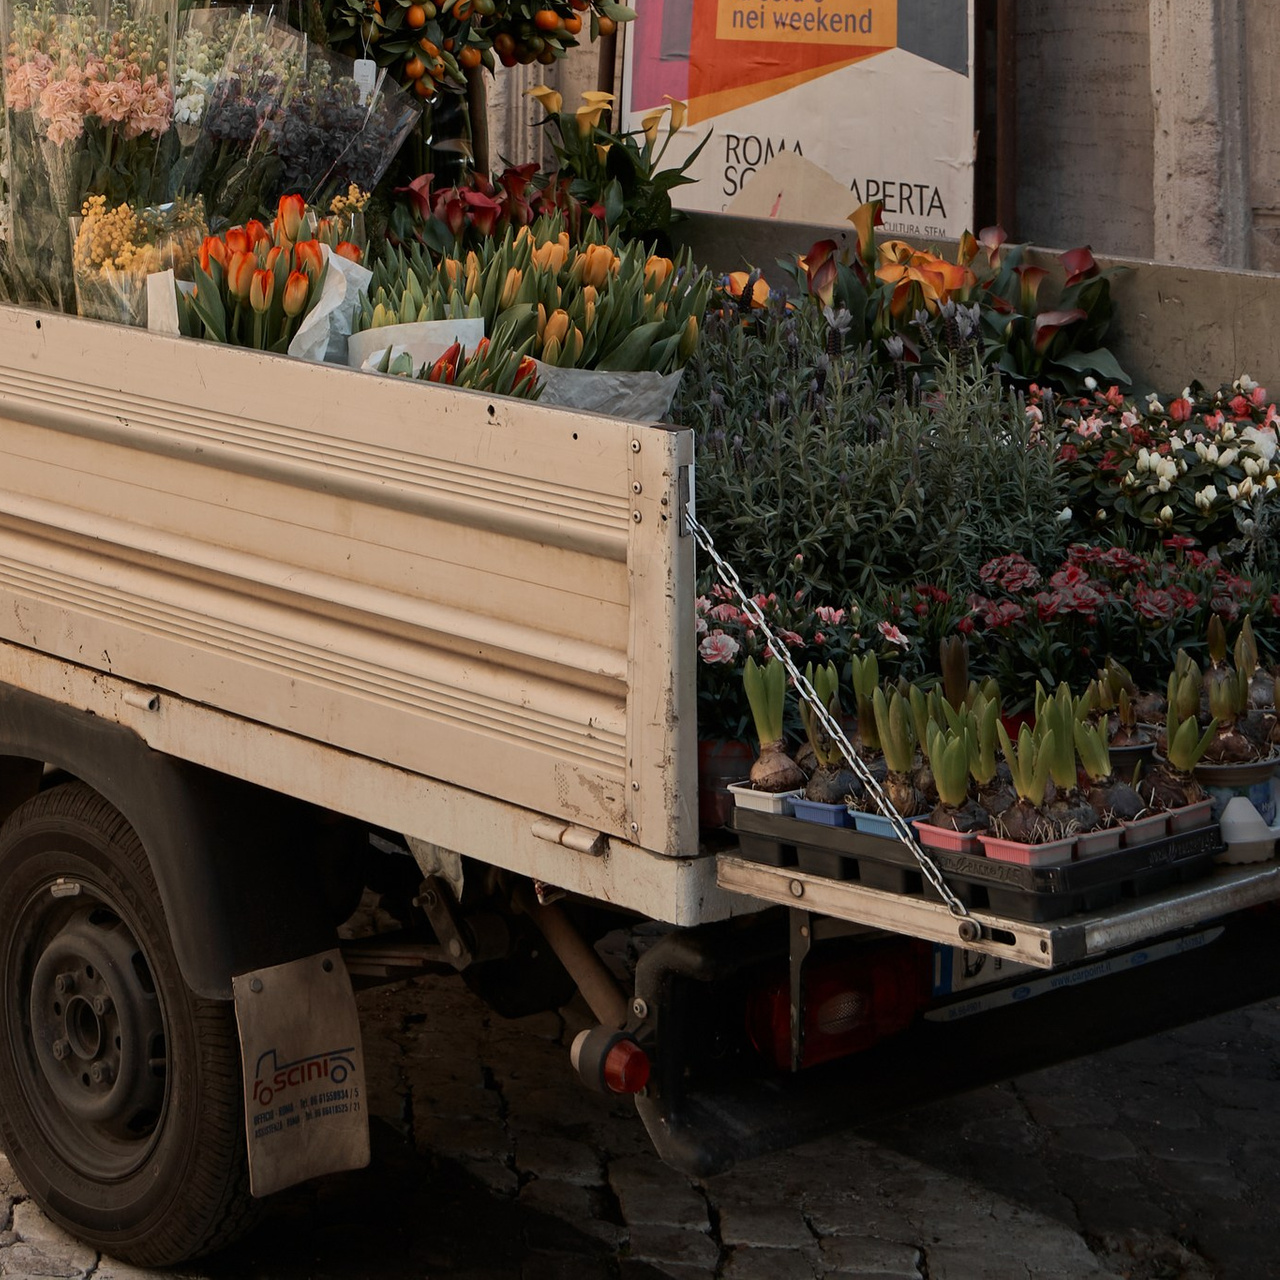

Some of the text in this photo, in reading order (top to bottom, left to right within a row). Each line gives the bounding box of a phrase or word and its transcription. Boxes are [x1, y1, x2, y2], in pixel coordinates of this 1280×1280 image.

[733, 4, 873, 34] nei weekend
[850, 178, 947, 219] APERTA
[1050, 961, 1111, 987] www.carpoint.it
